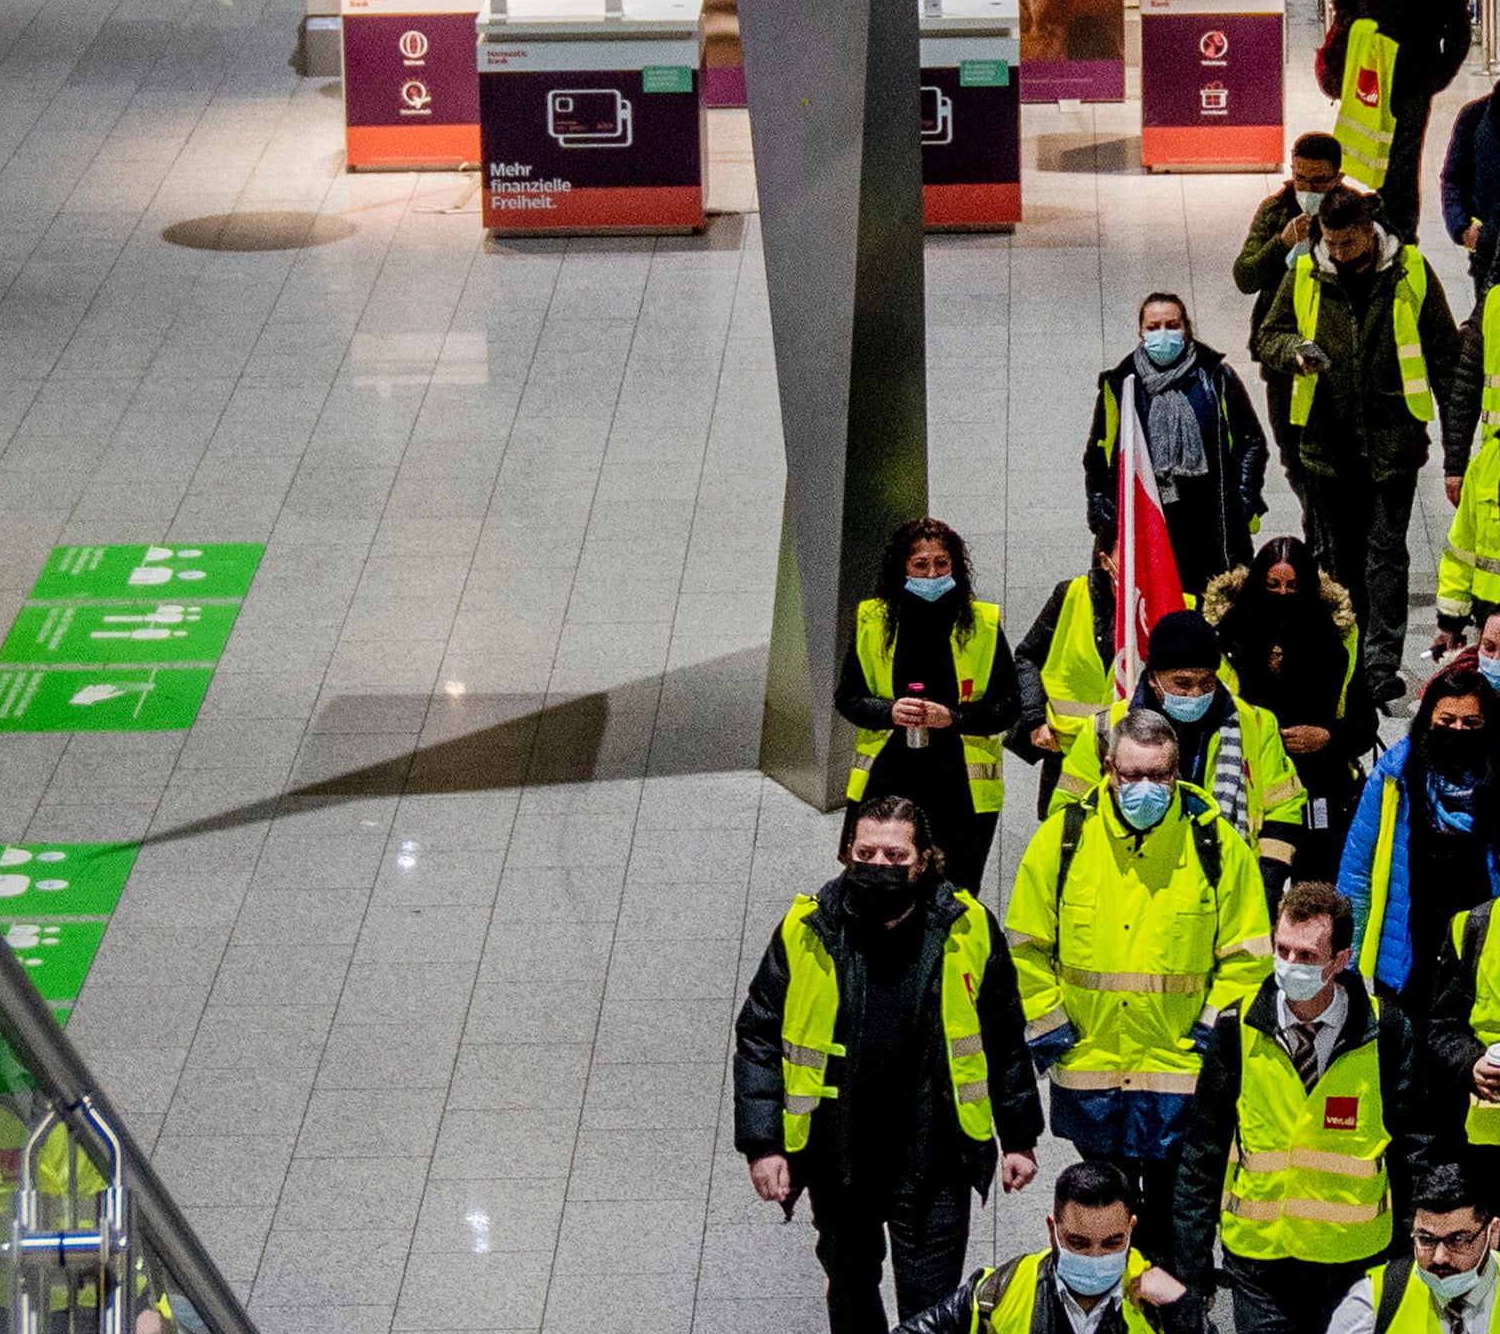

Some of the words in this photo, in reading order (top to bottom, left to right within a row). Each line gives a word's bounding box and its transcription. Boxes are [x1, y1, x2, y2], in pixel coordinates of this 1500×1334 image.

[490, 163, 532, 177] Mehr
[490, 179, 572, 194] finanzielle
[491, 195, 558, 210] Freiheit.
[1326, 1114, 1356, 1127] ver.di
